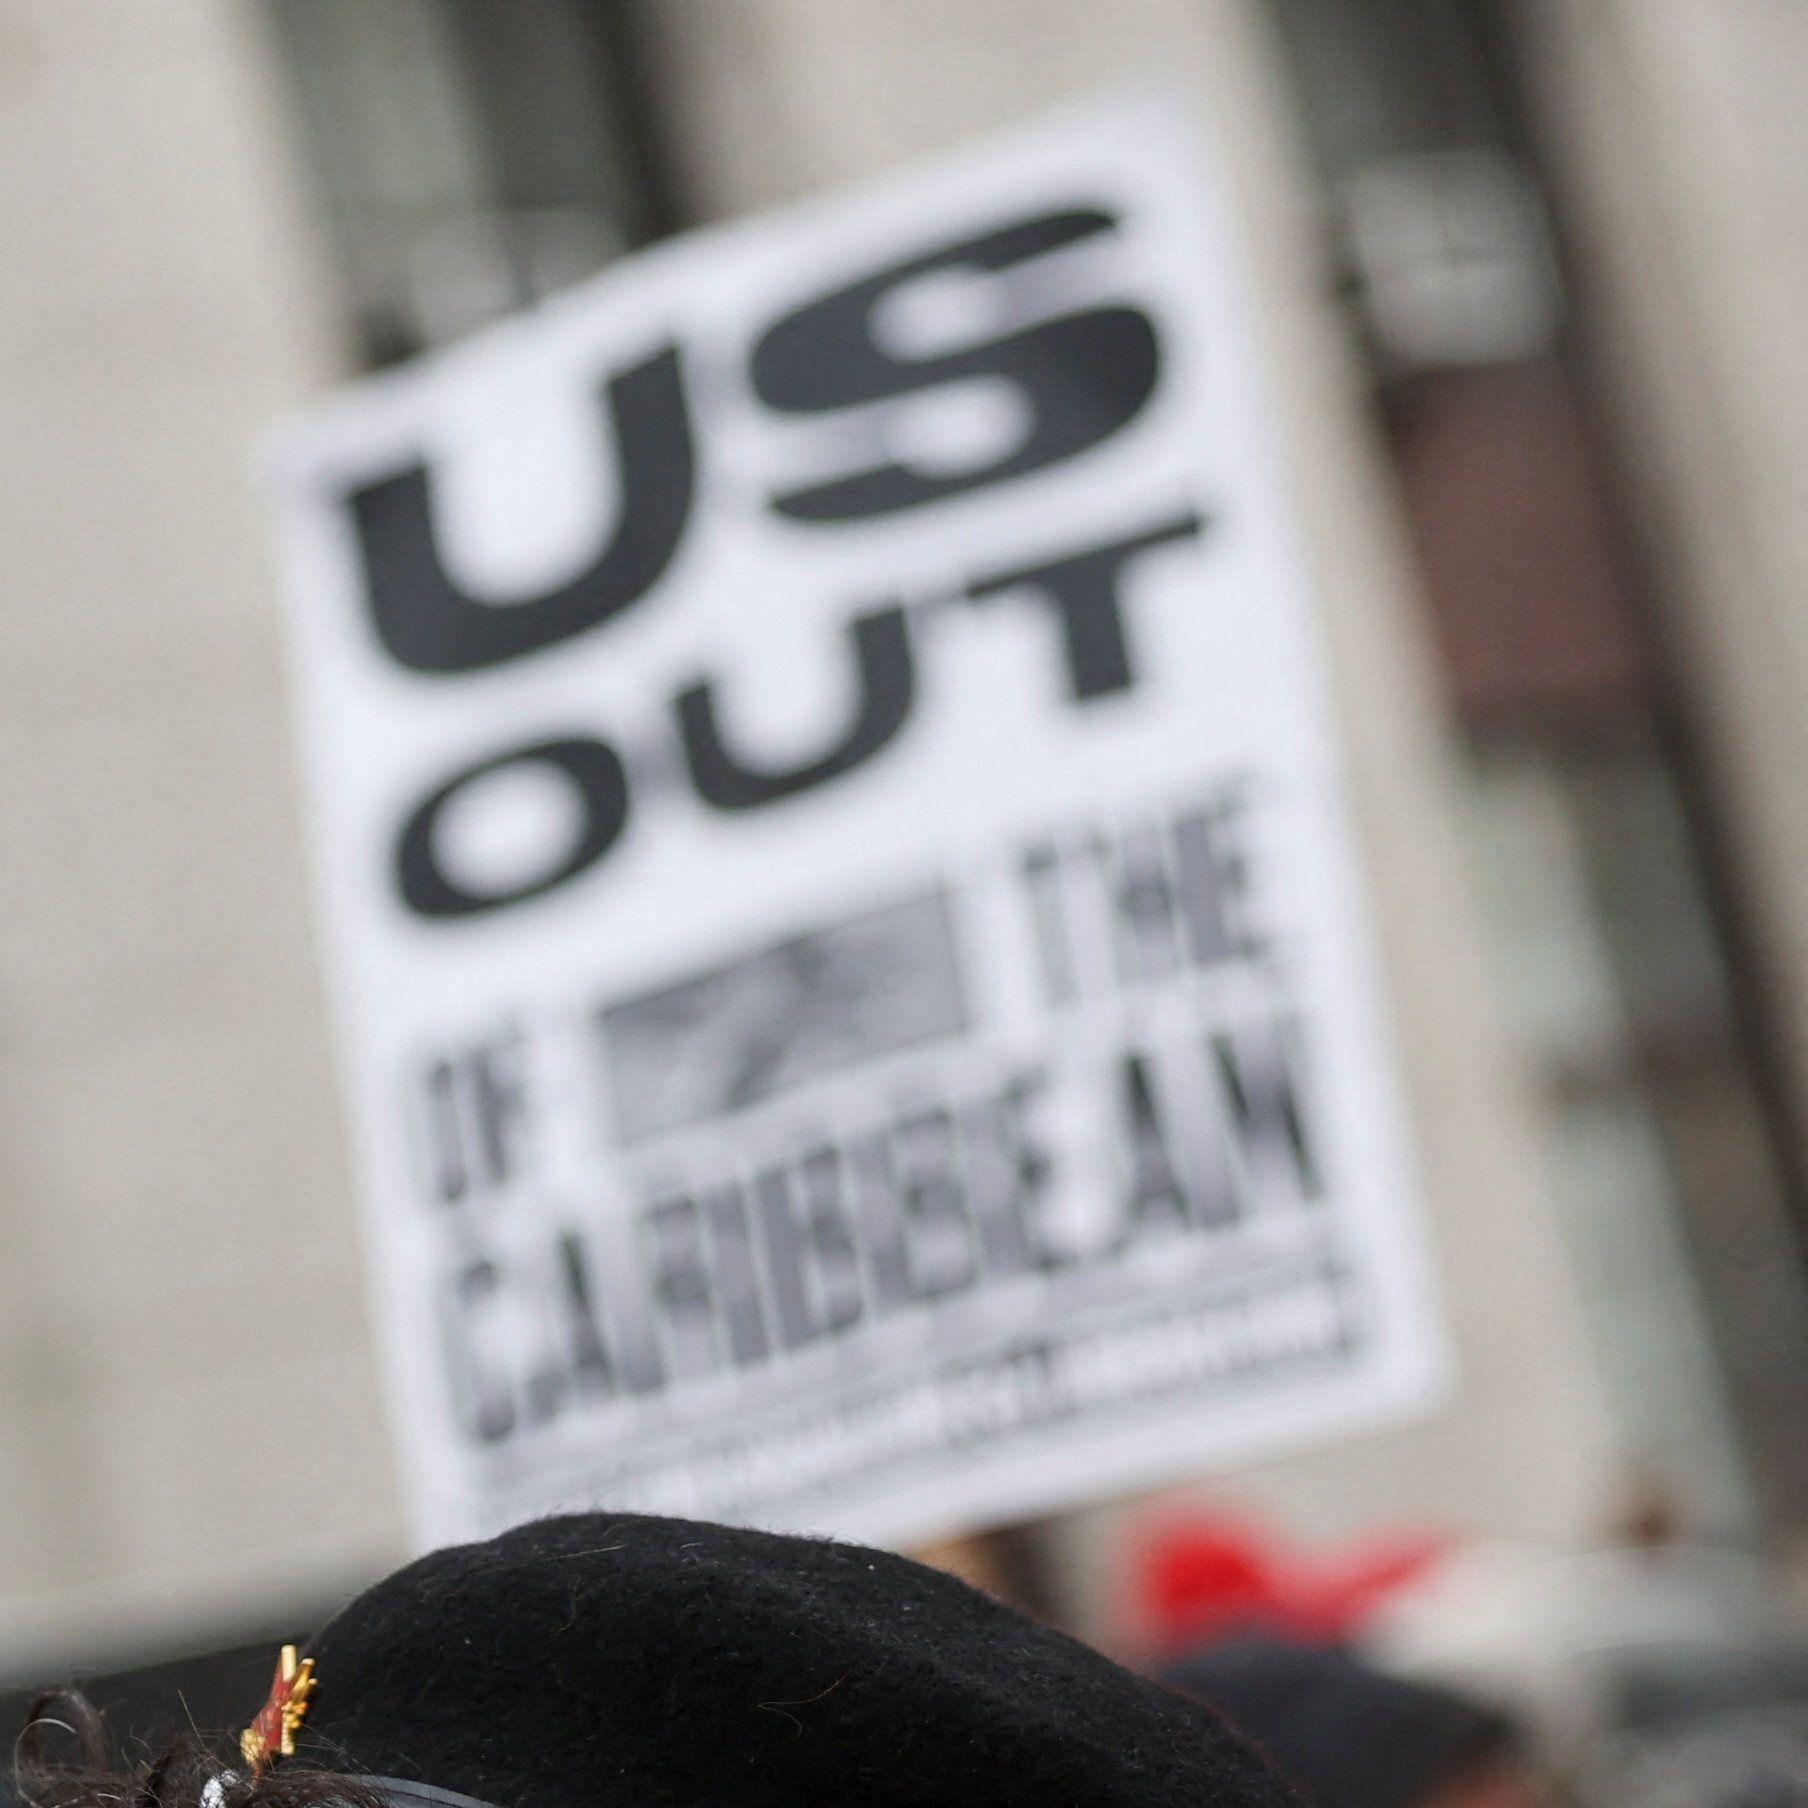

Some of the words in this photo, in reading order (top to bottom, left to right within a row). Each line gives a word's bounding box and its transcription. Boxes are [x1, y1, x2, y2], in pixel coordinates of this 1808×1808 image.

[346, 209, 1160, 676] US
[393, 512, 1209, 920] OUT
[446, 1014, 1322, 1442] CARIBBEAN
